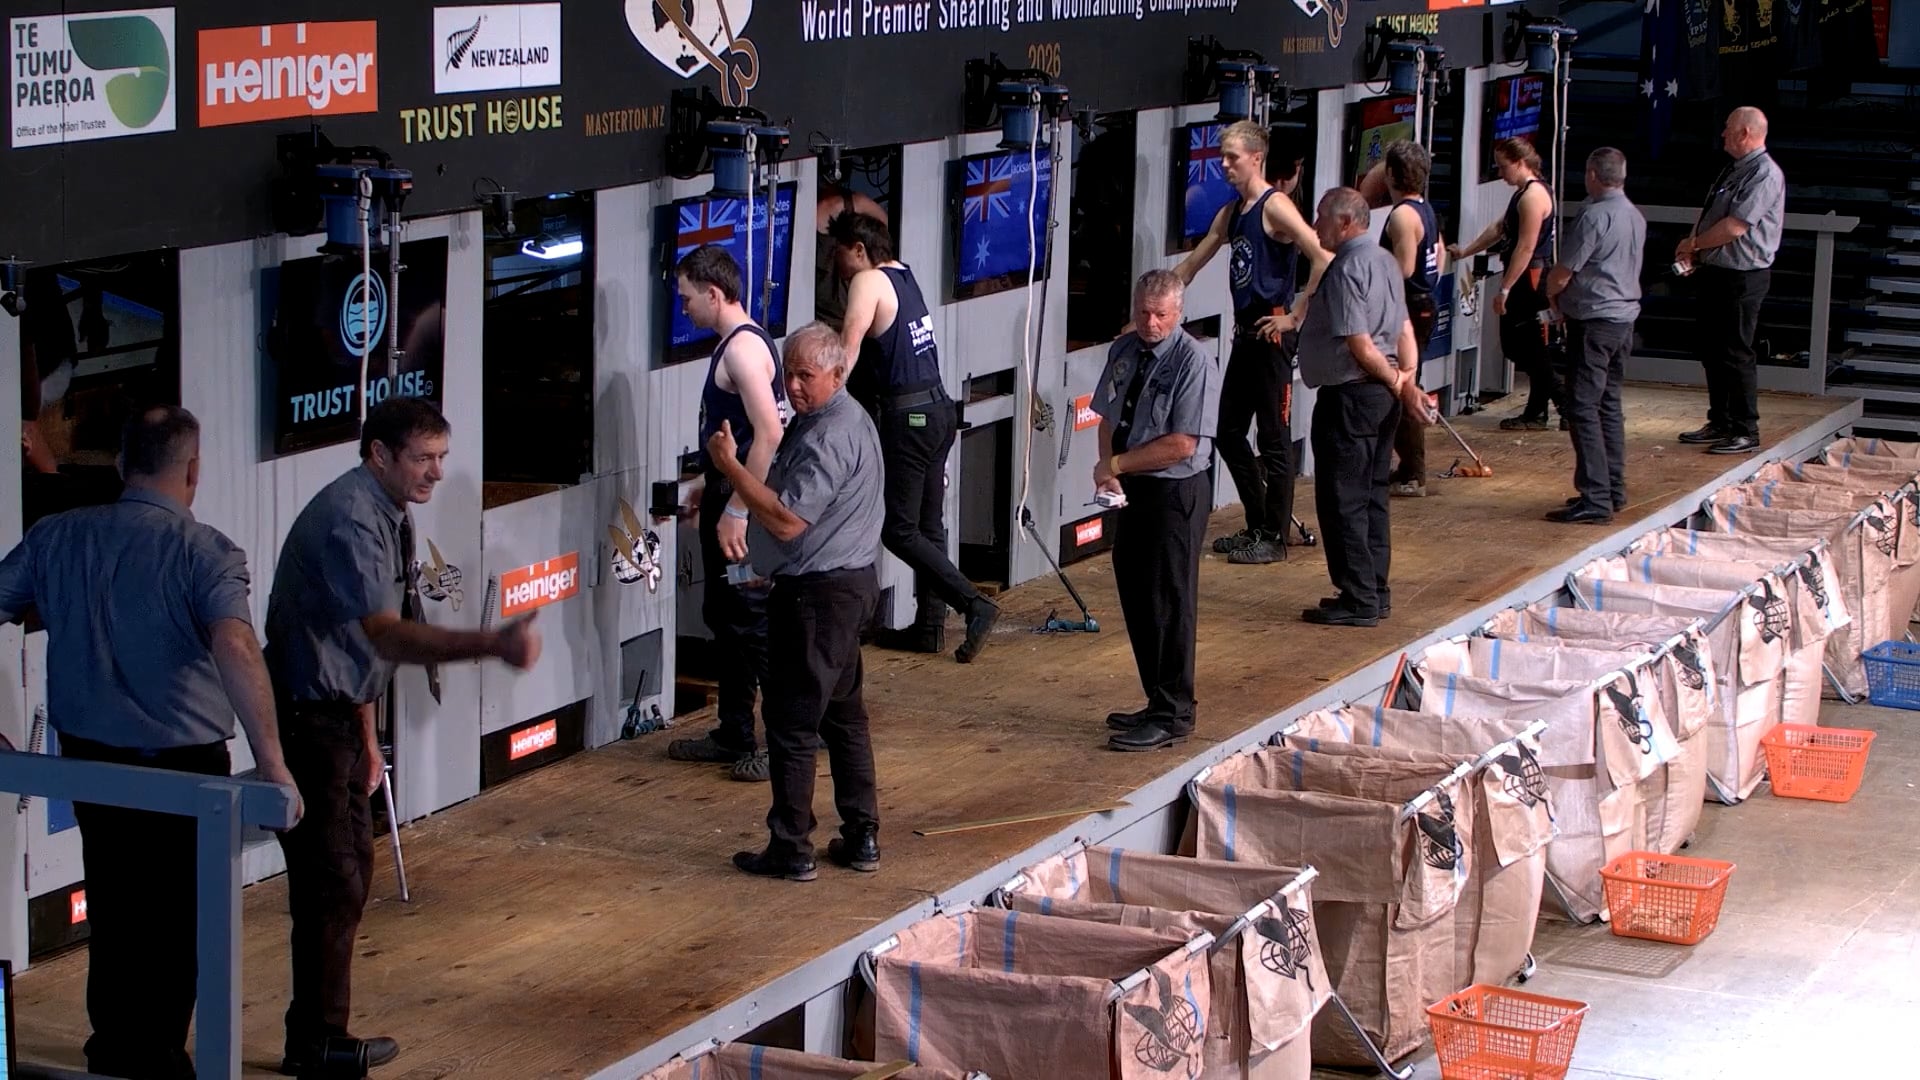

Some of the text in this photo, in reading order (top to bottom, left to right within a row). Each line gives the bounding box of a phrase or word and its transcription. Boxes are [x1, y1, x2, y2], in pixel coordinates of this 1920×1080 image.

[15, 23, 38, 48] TE
[802, 0, 852, 41] World
[862, 0, 931, 36] Premier
[939, 0, 1010, 31] Shearing
[1017, 0, 1043, 23] and
[1376, 13, 1439, 34] TUST HOUSE
[16, 49, 72, 78] TUMU
[206, 23, 374, 109] Heiniger
[471, 47, 549, 68] NEW ZEALAND
[1028, 43, 1061, 78] 2026
[17, 77, 95, 108] PAEROA
[16, 126, 36, 137] Office
[38, 124, 45, 135] of
[46, 123, 58, 134] the
[80, 119, 106, 130] Trustee
[400, 95, 563, 144] TRUST HOUSE
[585, 105, 665, 137] MASTERTON.NZ
[291, 370, 425, 423] TRUST HOSE
[506, 560, 577, 608] Heiniger
